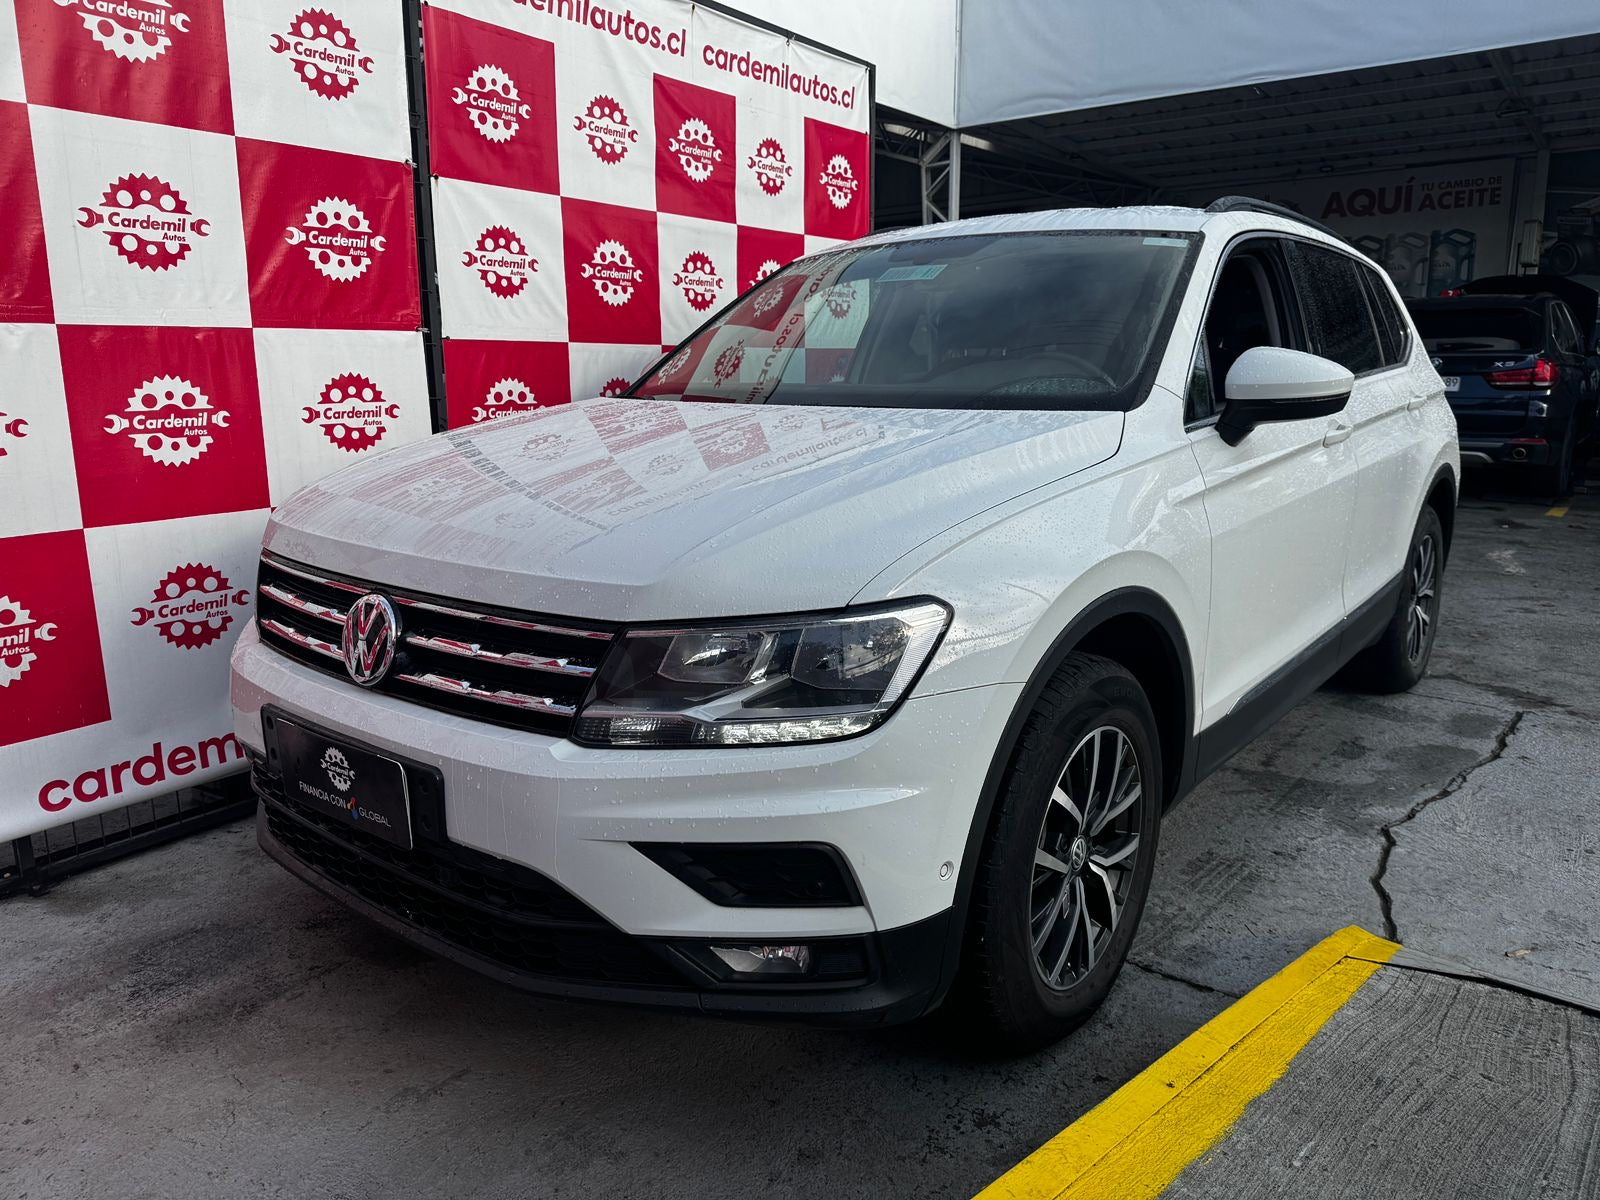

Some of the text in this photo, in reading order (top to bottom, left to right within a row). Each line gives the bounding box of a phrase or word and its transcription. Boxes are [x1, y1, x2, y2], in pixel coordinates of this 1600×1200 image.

[139, 22, 166, 35] Autos
[293, 41, 355, 68] Cardemil
[335, 65, 355, 77] Autos
[702, 44, 856, 110] cardemilautos.cl
[469, 93, 517, 114] Cardemil
[501, 112, 517, 122] Autos
[588, 120, 627, 139] Cardemil
[679, 141, 713, 159] Cardemil
[756, 159, 785, 174] Cardemil
[827, 175, 851, 188] Cardemil
[1420, 175, 1503, 192] TU CAMBIO DE
[1321, 176, 1416, 219] AQUÍ
[1418, 186, 1502, 212] ACEITE
[107, 211, 186, 234] Cardemil
[162, 232, 187, 243] Autos
[308, 230, 368, 249] Cardemil
[349, 248, 368, 257] Autos
[479, 255, 526, 270] Cardemil
[509, 268, 526, 277] Autos
[594, 268, 632, 280] Cardemil
[683, 276, 715, 288] Cardemil
[132, 411, 208, 430] Cardemil
[323, 405, 382, 421] Cardemil
[363, 418, 383, 427] Autos
[183, 427, 208, 436] Autos
[158, 593, 229, 619] Cardemil
[205, 608, 229, 620] Autos
[1, 646, 31, 657] Autos
[327, 762, 349, 776] Cardemil
[299, 780, 392, 828] FINANCIA CON GLOBAL
